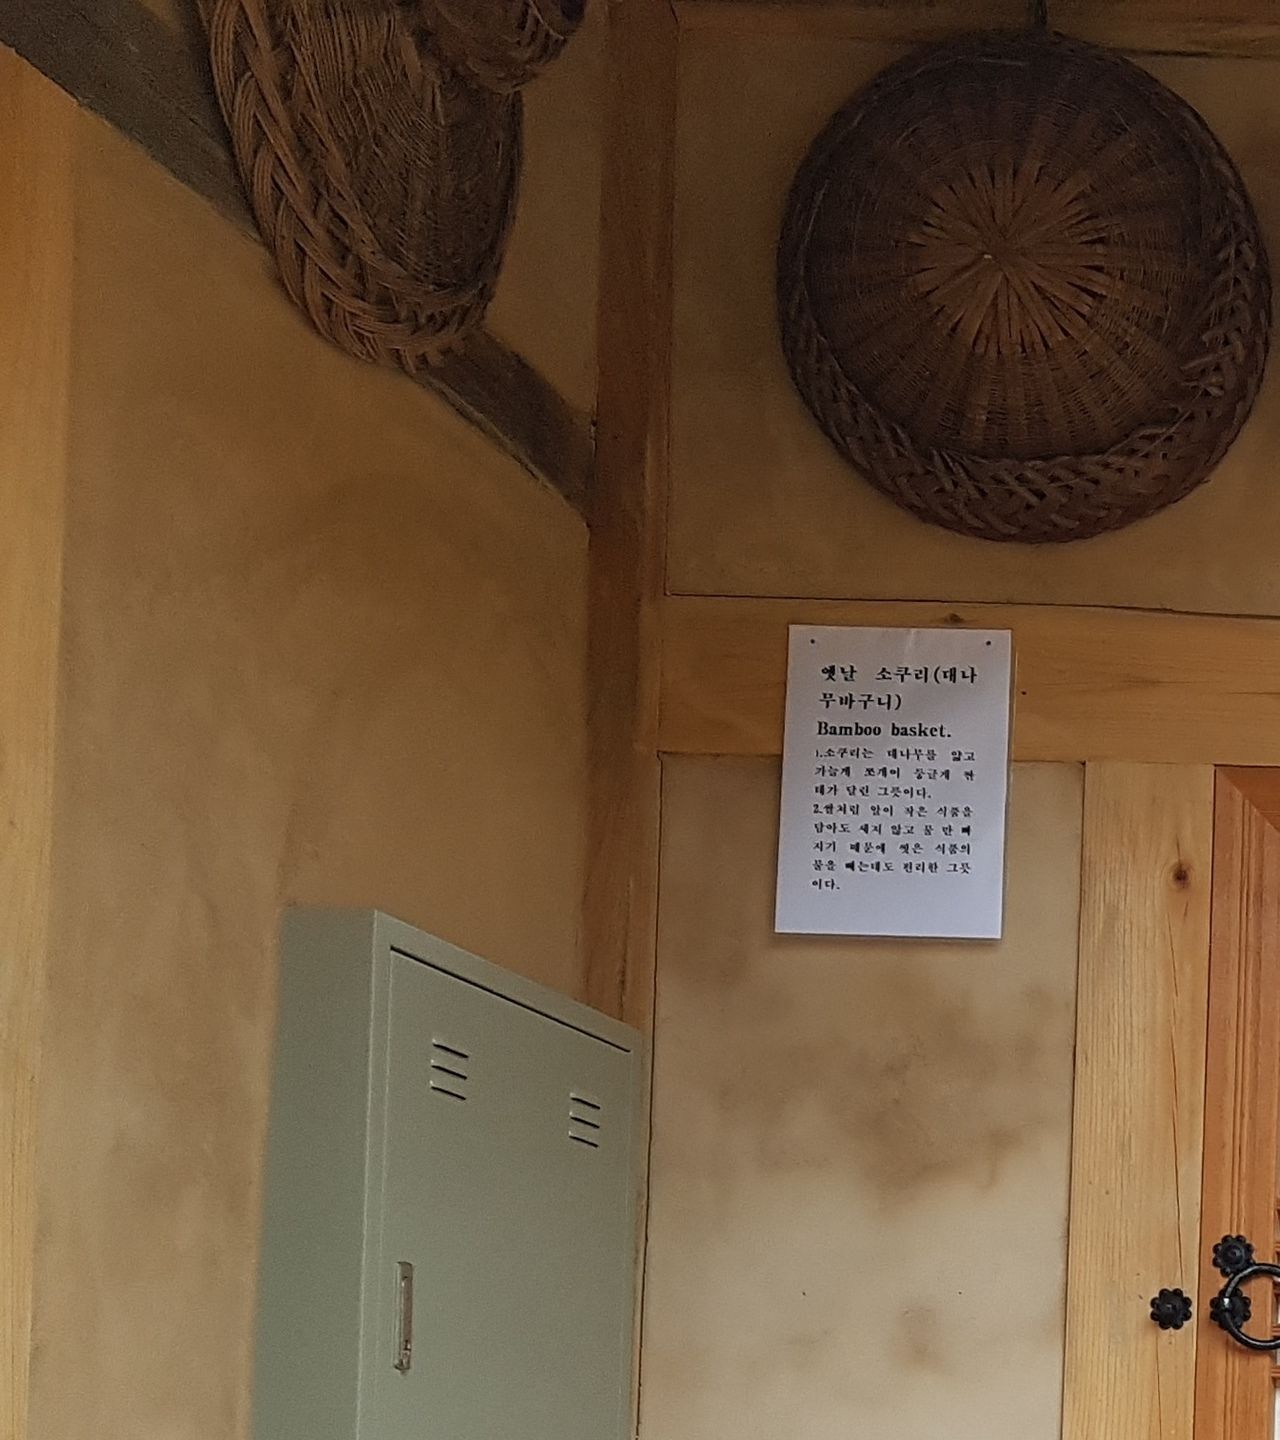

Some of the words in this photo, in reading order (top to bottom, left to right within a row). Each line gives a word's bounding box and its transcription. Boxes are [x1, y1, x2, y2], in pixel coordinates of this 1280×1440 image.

[822, 665, 857, 681] 옛날
[875, 666, 977, 684] 소쿠리(대나
[819, 693, 901, 710] 무바구니)
[818, 721, 881, 736] Bamboo
[892, 723, 951, 737] basket.
[887, 748, 936, 761] 대나무를
[878, 787, 931, 799] 그릇이다.
[812, 879, 840, 890] 이다.
